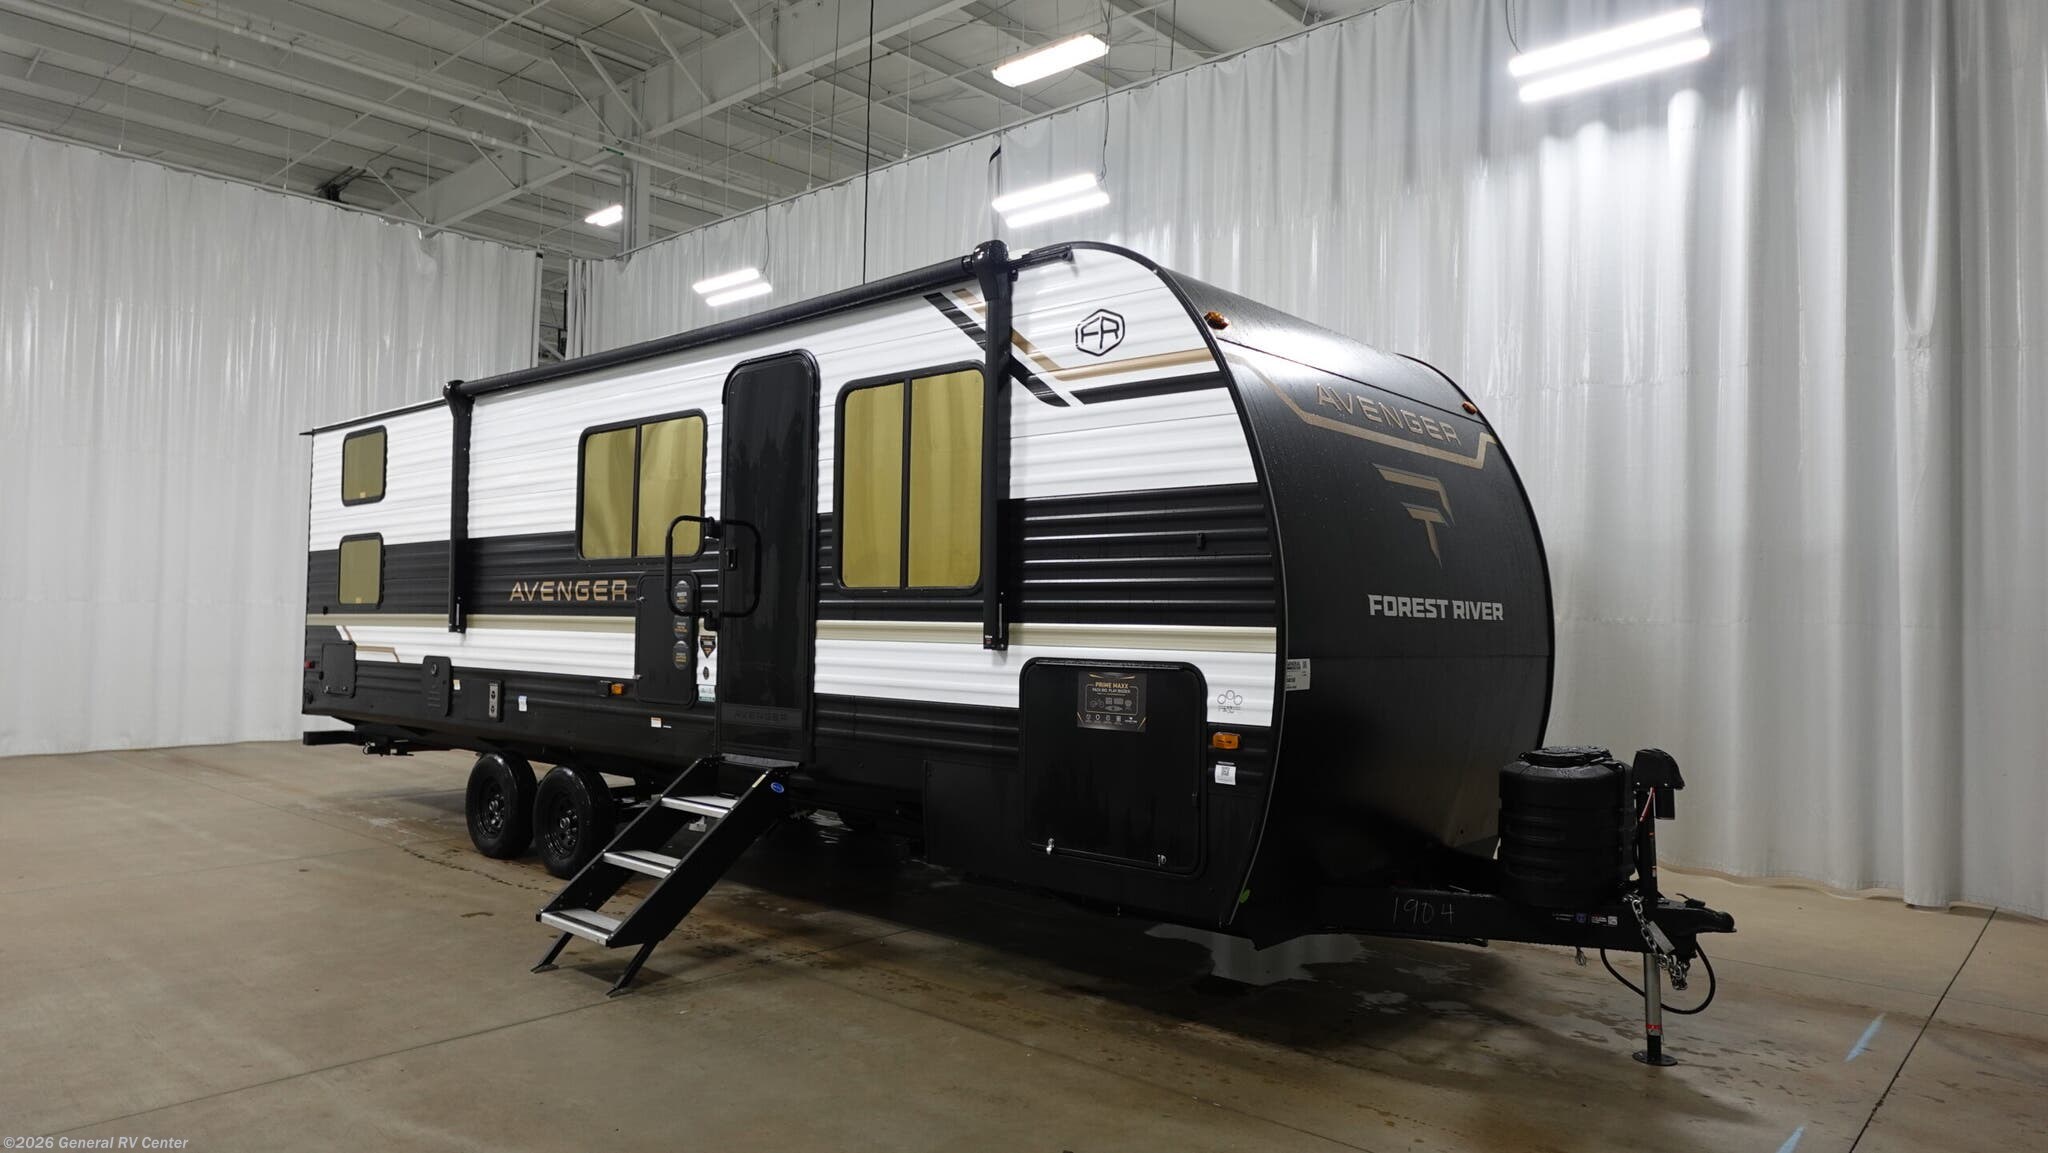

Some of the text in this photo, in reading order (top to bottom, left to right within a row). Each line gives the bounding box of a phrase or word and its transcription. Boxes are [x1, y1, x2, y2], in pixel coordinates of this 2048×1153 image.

[1316, 382, 1462, 447] AVENGER
[509, 579, 628, 602] AVENGER
[1367, 594, 1504, 621] FOREST RIVER
[1392, 896, 1456, 926] 1904
